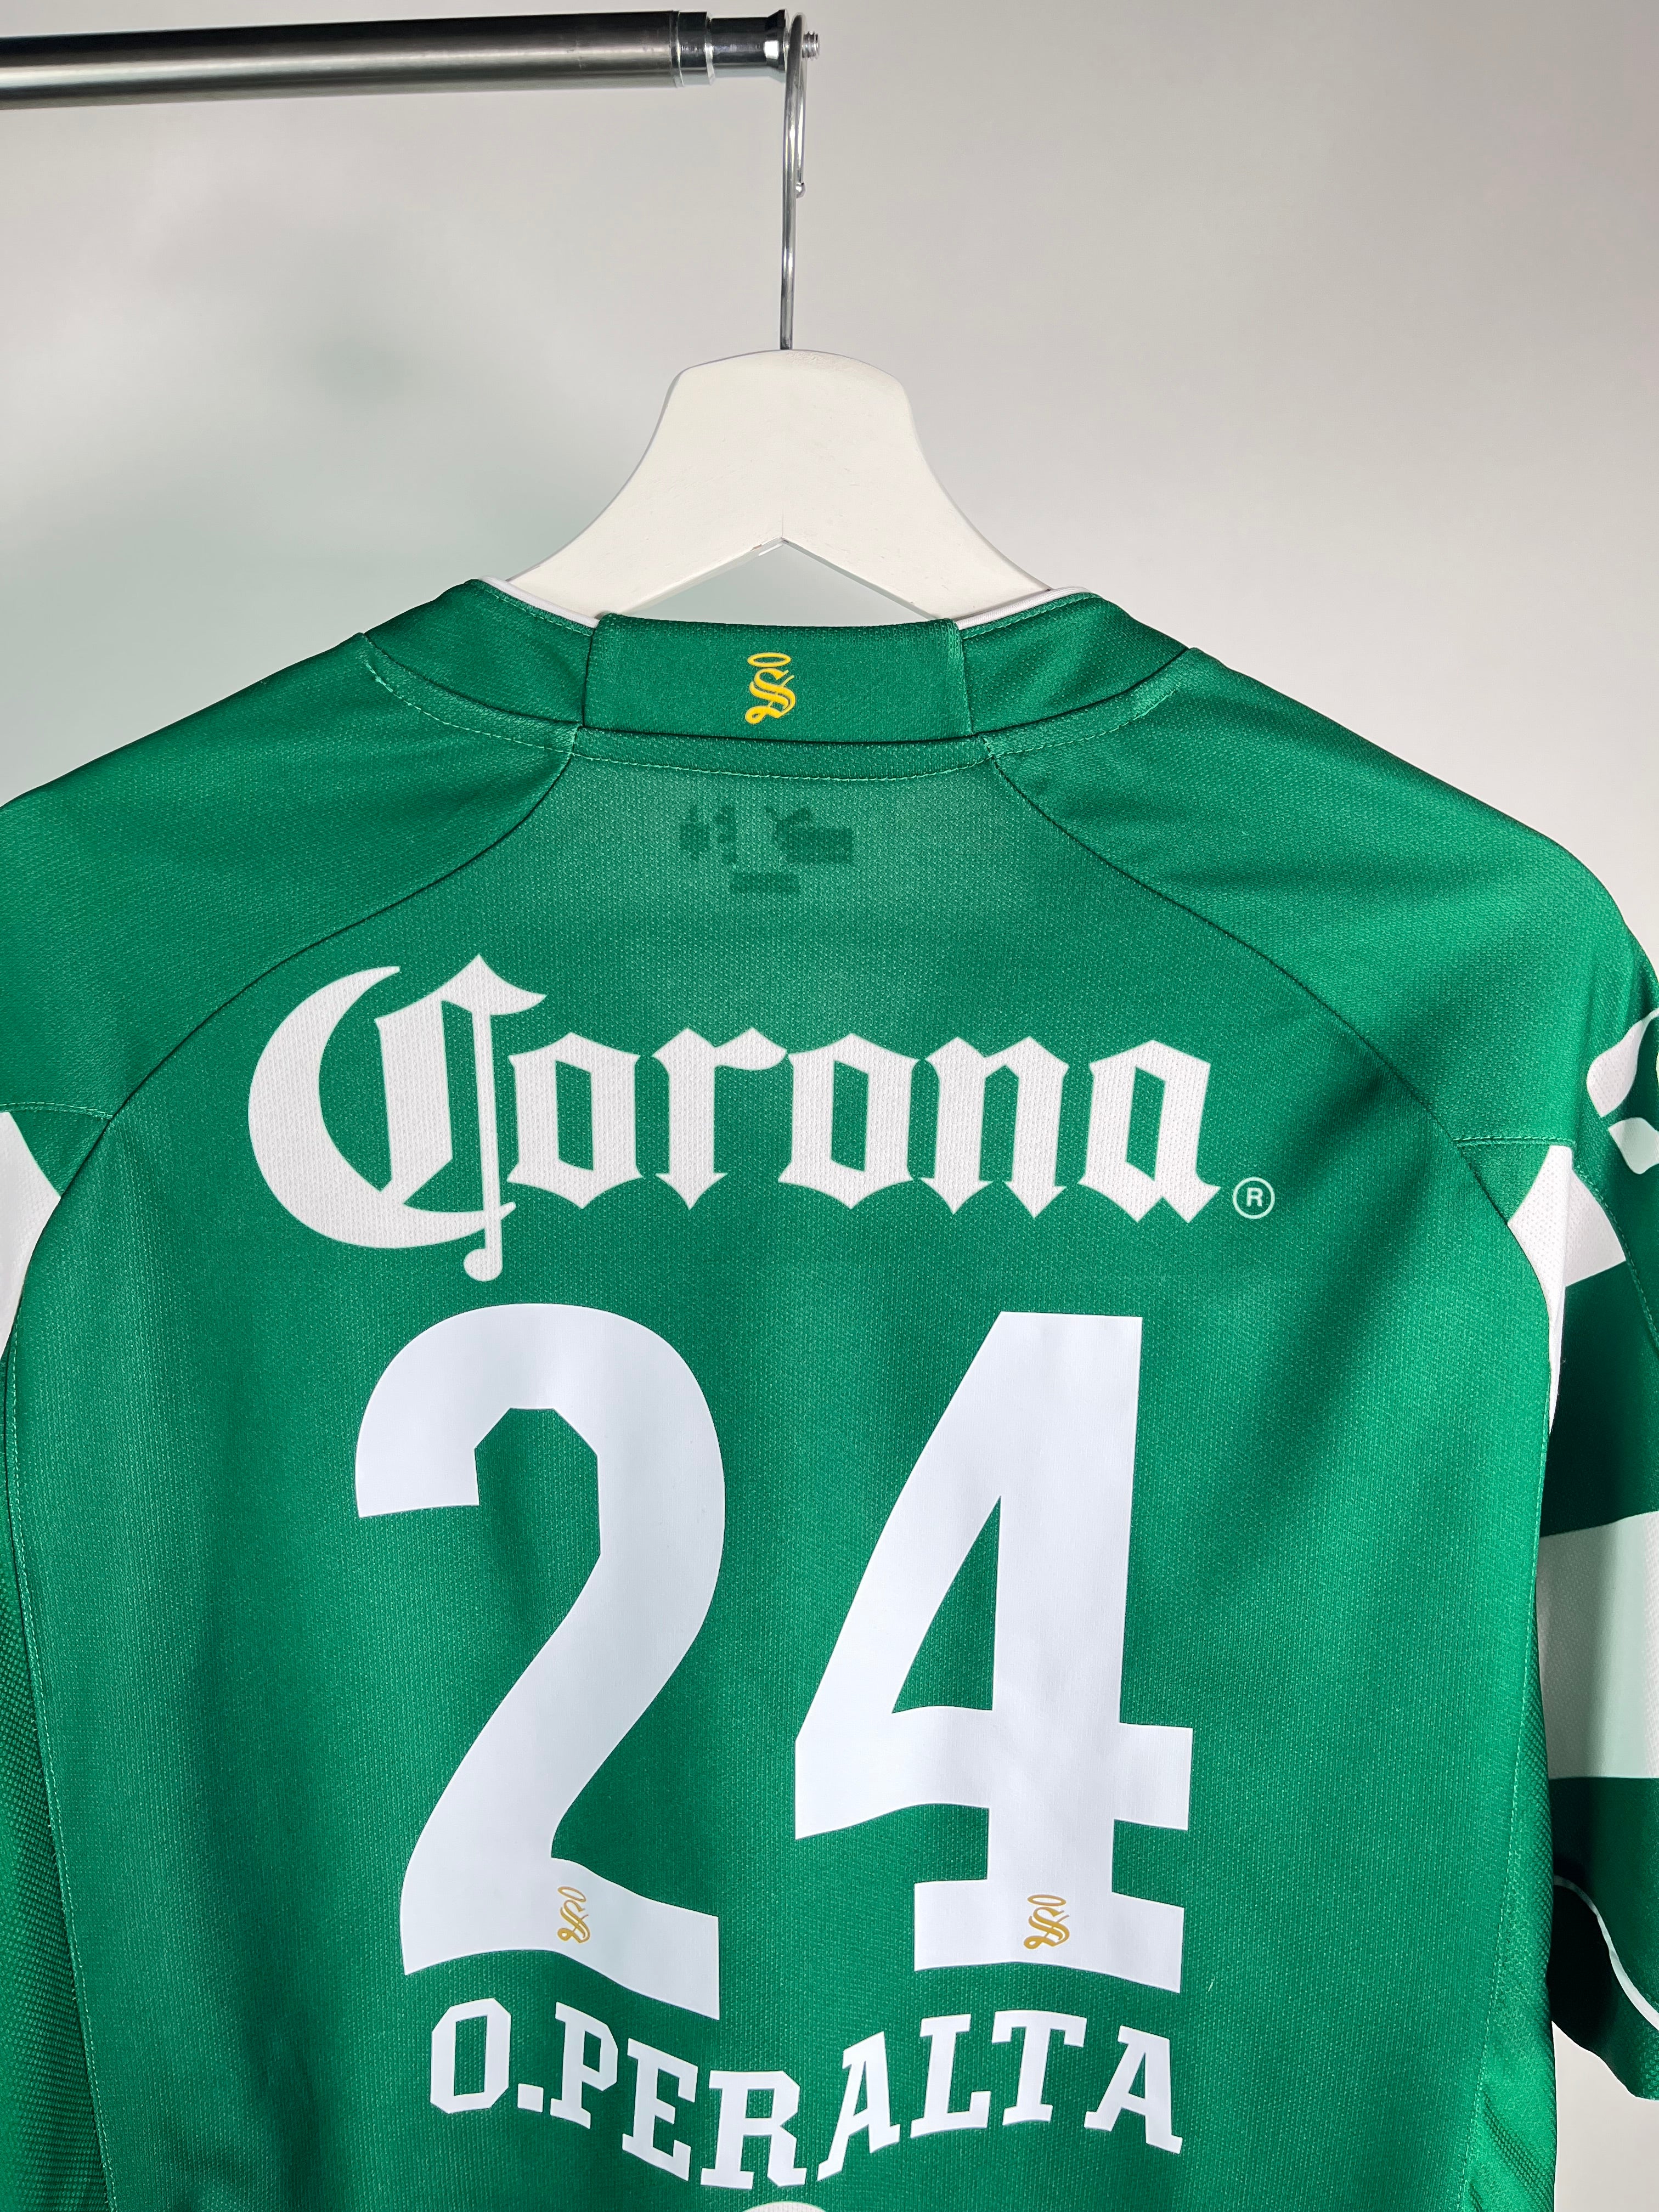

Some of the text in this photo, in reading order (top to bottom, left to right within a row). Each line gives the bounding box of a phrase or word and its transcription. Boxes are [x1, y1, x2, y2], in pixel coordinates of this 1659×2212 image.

[248, 954, 1221, 1282] Corona
[354, 1302, 1194, 2021] 24
[430, 1997, 1183, 2190] O.PERALTA
